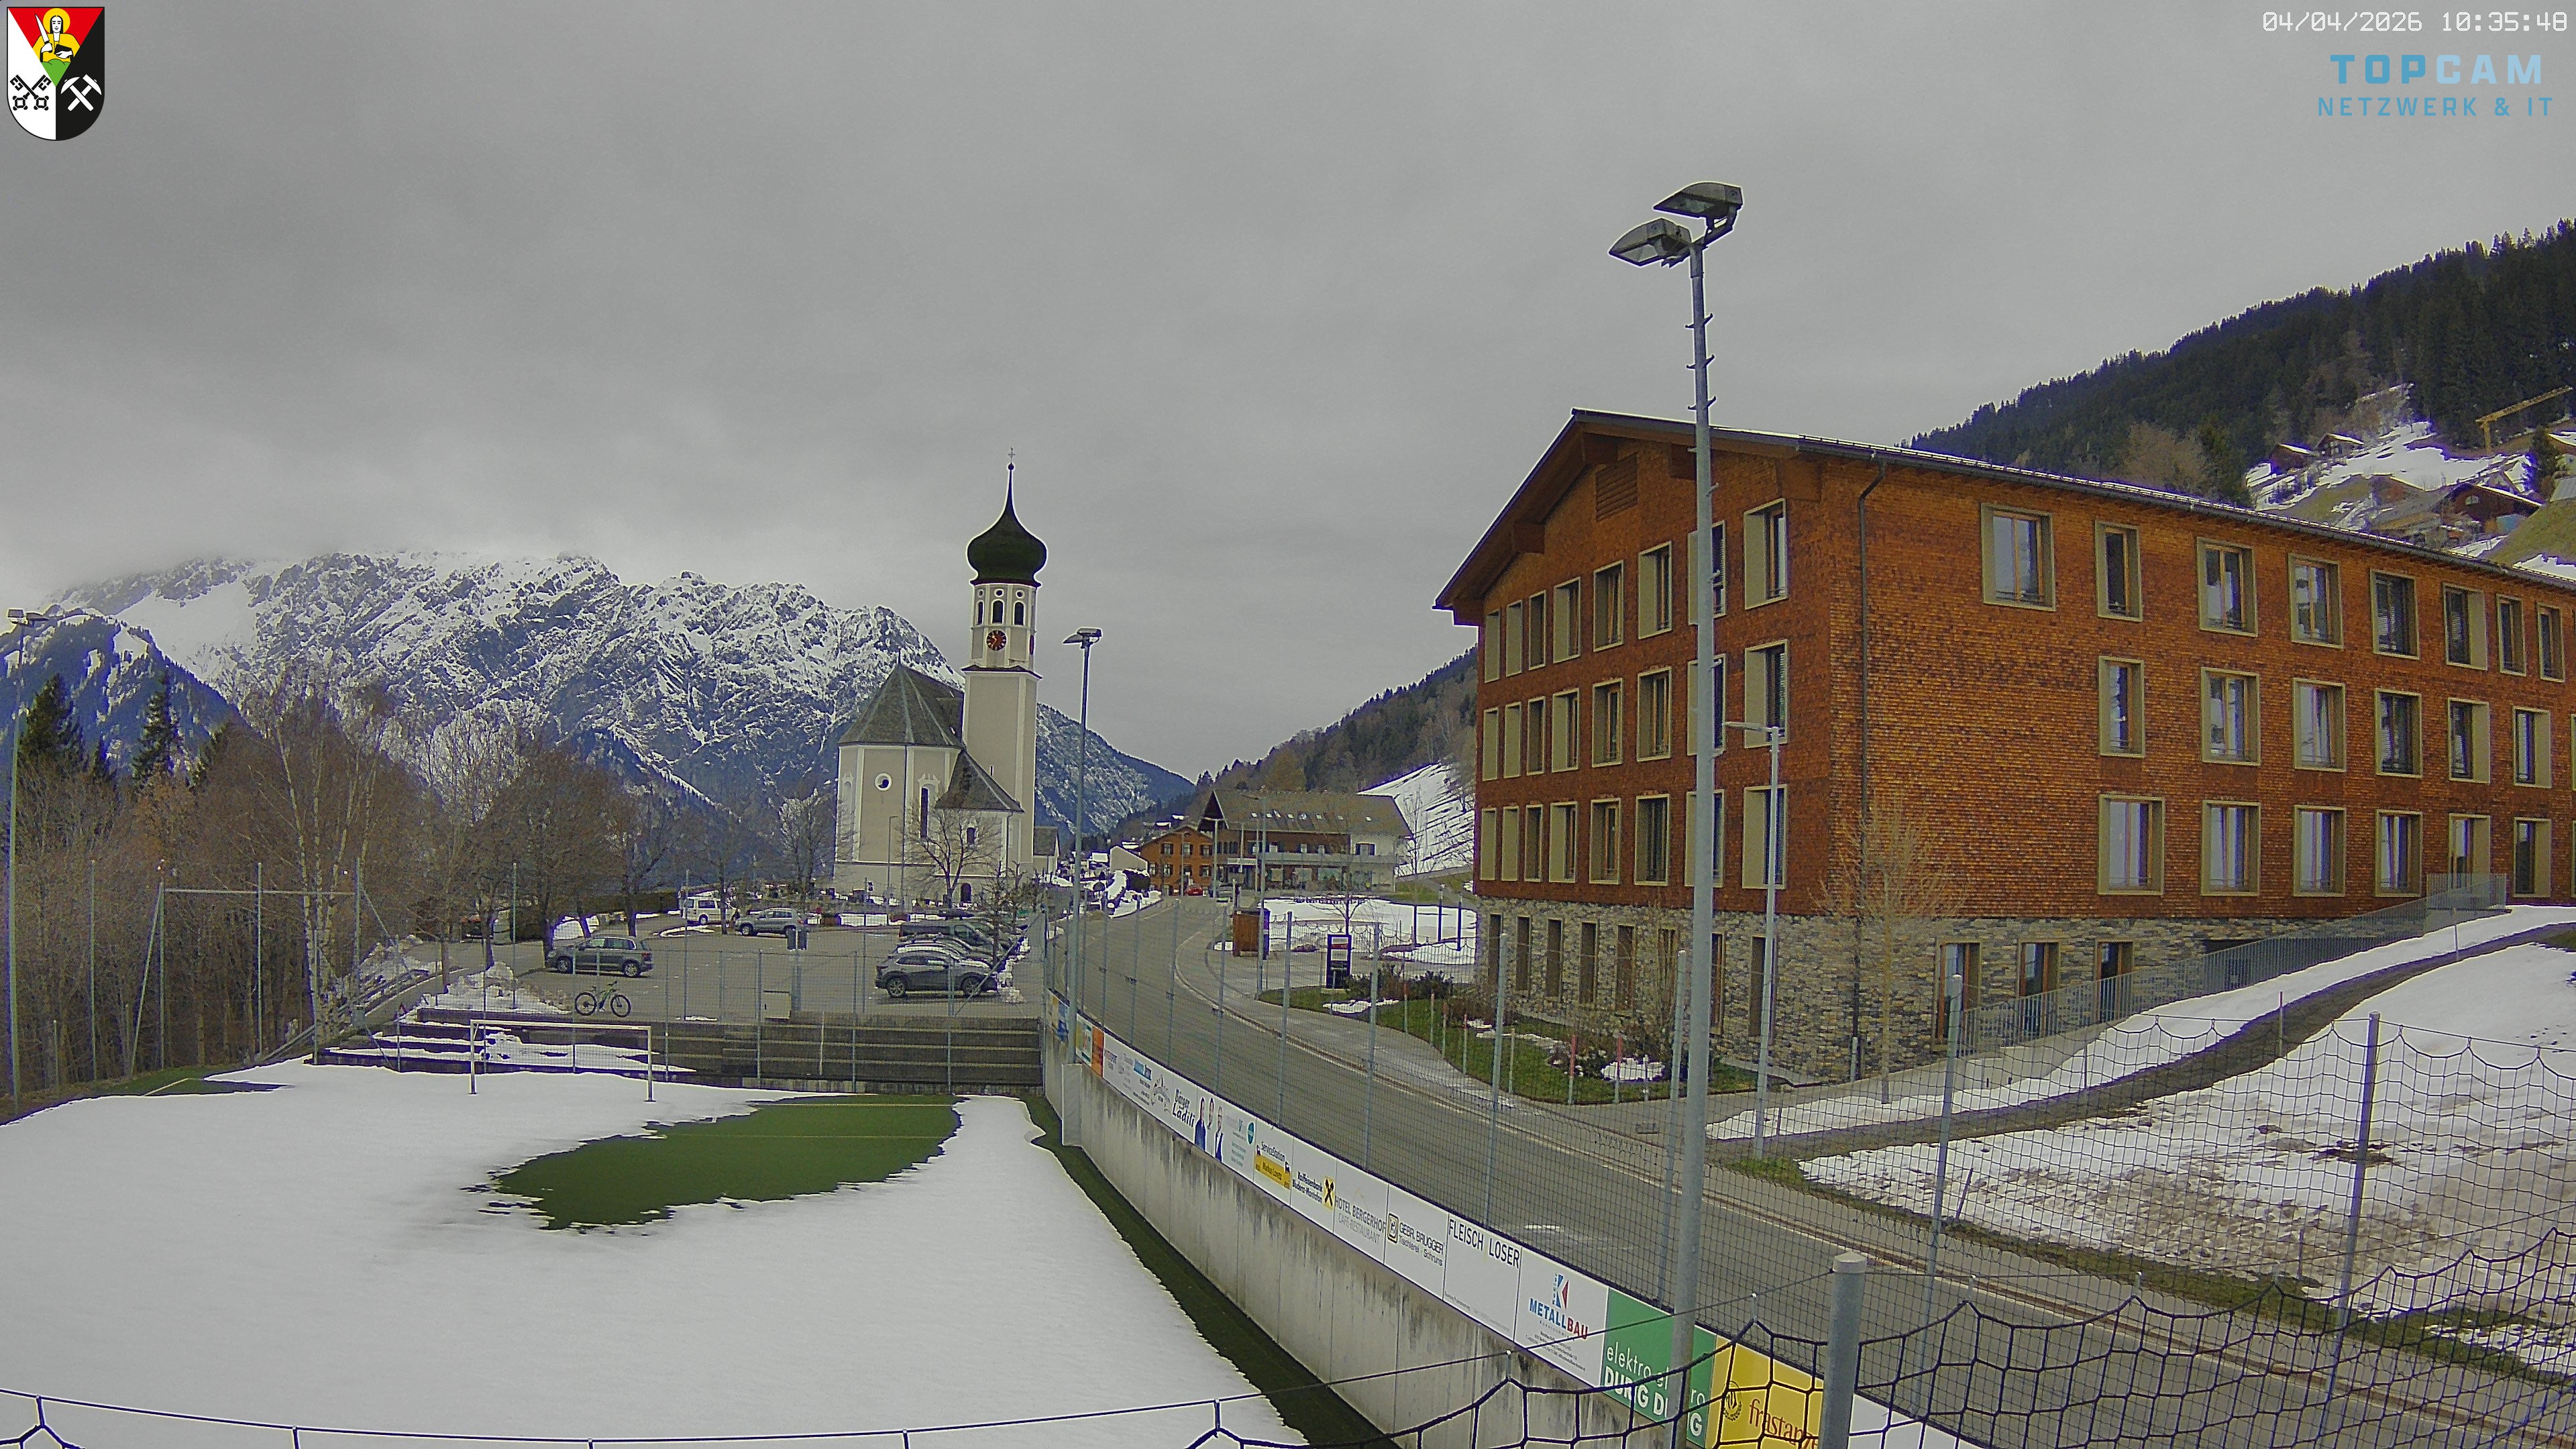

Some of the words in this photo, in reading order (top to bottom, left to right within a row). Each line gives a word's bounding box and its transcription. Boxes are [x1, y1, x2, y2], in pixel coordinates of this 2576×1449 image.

[1335, 1196, 1351, 1215] HOTEL
[1352, 1205, 1386, 1234] BERGERHOF
[1448, 1218, 1484, 1252] FLEISCH
[1489, 1238, 1520, 1269] LOSER
[1529, 1297, 1589, 1340] METALLBAU
[1607, 1342, 1651, 1379] elektro
